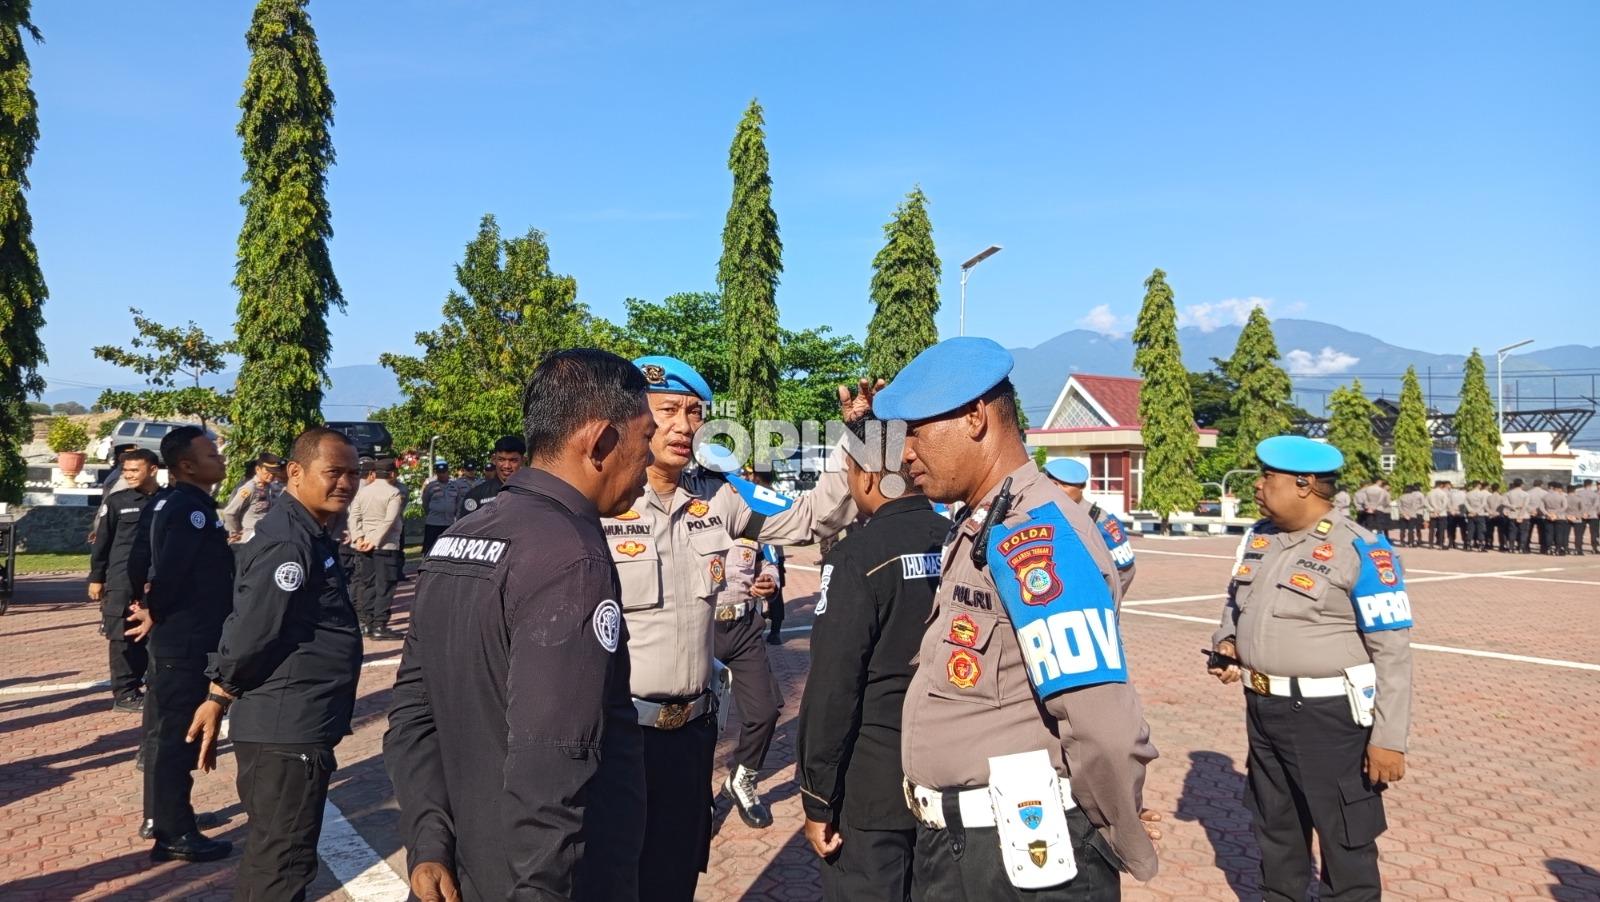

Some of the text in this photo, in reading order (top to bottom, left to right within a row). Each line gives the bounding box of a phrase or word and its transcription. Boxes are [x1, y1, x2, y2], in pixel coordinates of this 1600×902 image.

[686, 515, 723, 532] POLRI
[1002, 527, 1048, 551] POLDA
[461, 539, 506, 563] POLRI
[1296, 558, 1331, 575] POLRI
